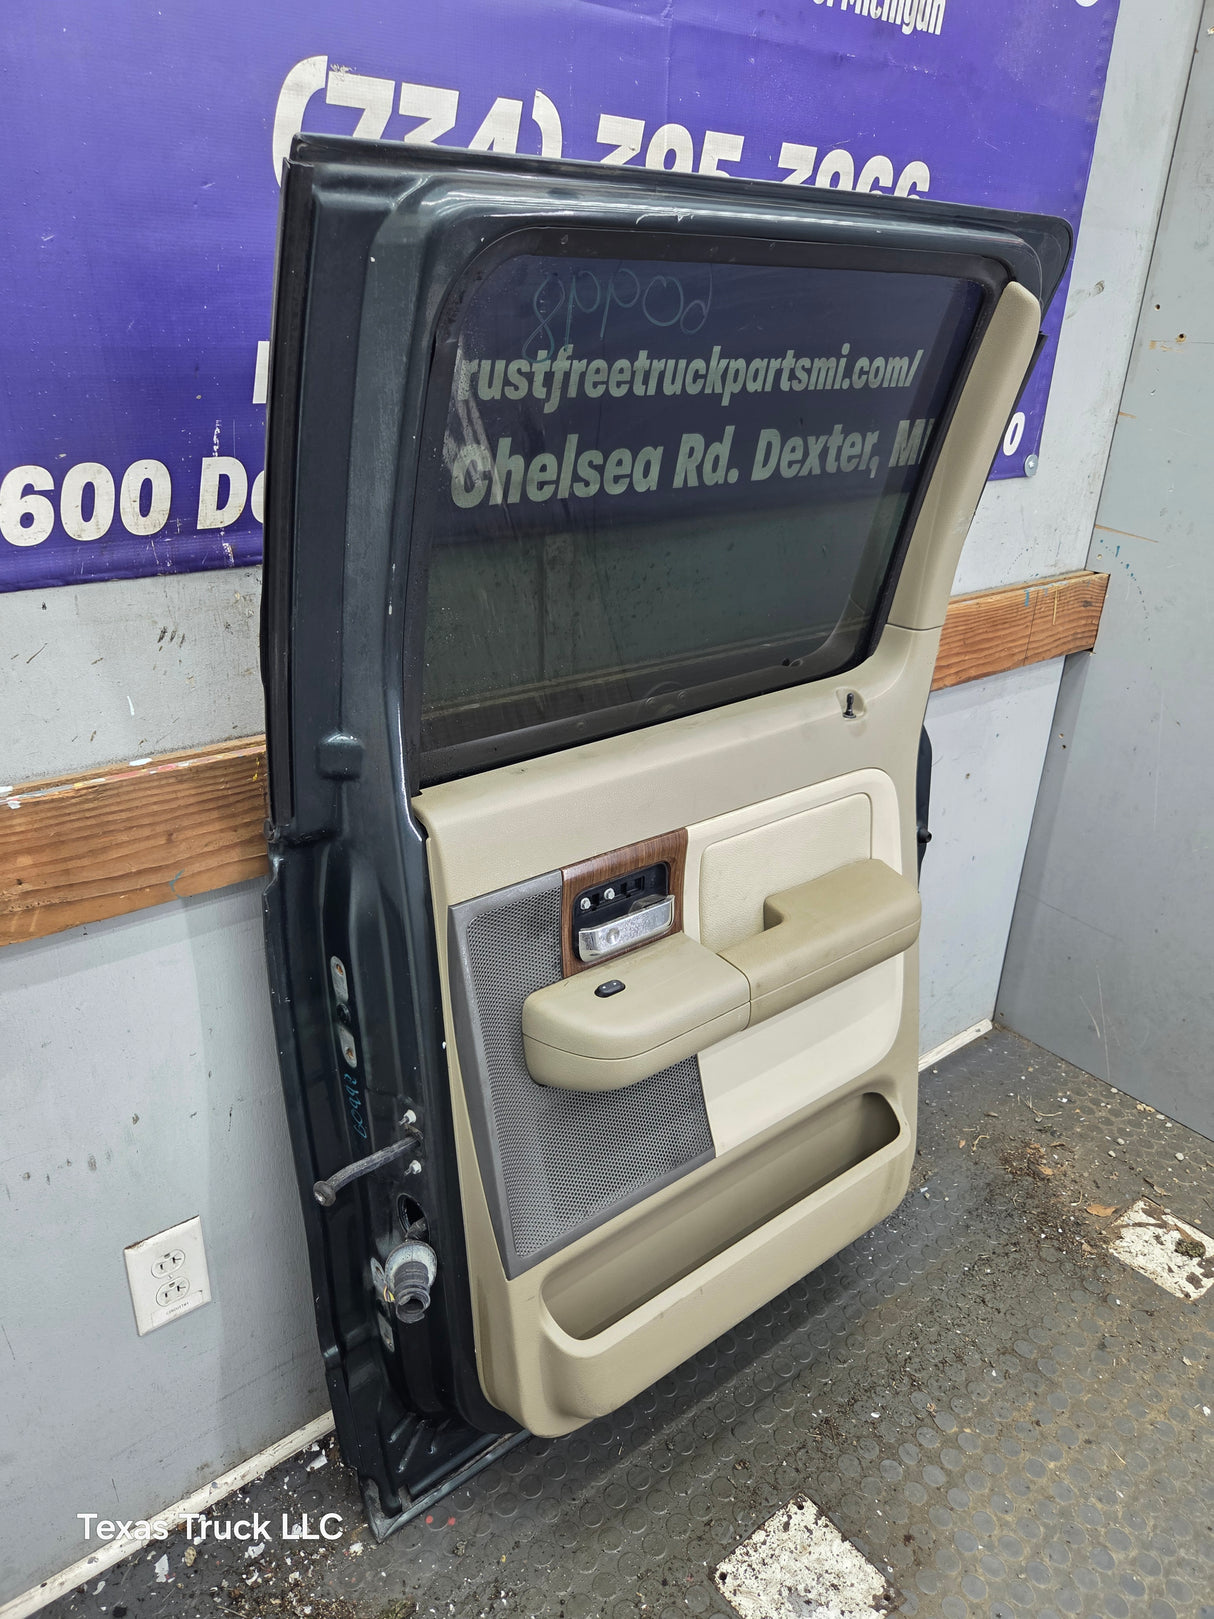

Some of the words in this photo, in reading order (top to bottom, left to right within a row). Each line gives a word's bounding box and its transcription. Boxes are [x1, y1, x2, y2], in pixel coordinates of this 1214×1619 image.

[0, 458, 172, 547] 600
[451, 434, 664, 508] Chelsea
[672, 425, 739, 488] Rd.
[751, 424, 880, 479] Dexter,
